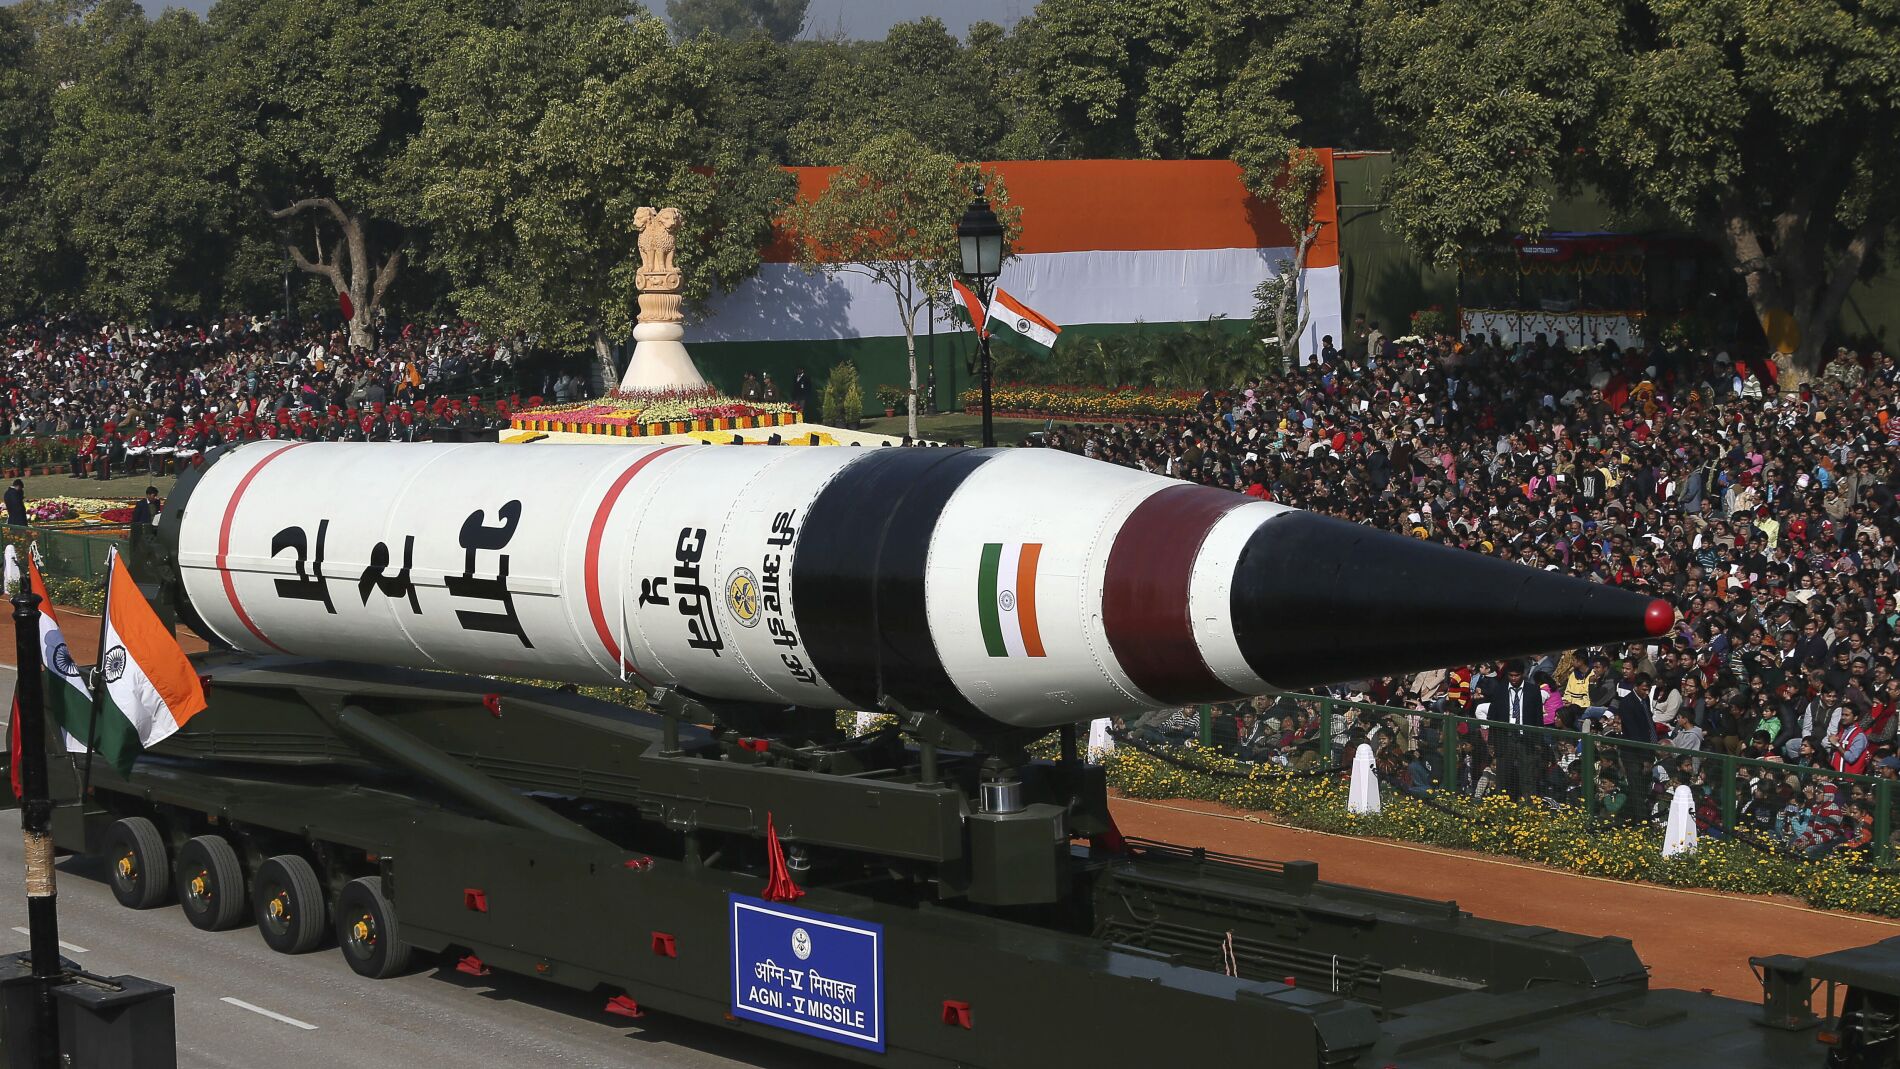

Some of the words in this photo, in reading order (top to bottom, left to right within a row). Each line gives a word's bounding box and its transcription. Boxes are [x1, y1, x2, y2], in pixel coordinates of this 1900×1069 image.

[767, 508, 796, 550] डी
[674, 527, 725, 658] अग्नि
[780, 653, 819, 687] ओ
[748, 985, 783, 1009] AGNI
[807, 999, 865, 1029] MISSILE
[809, 968, 857, 1004] मिसाइल
